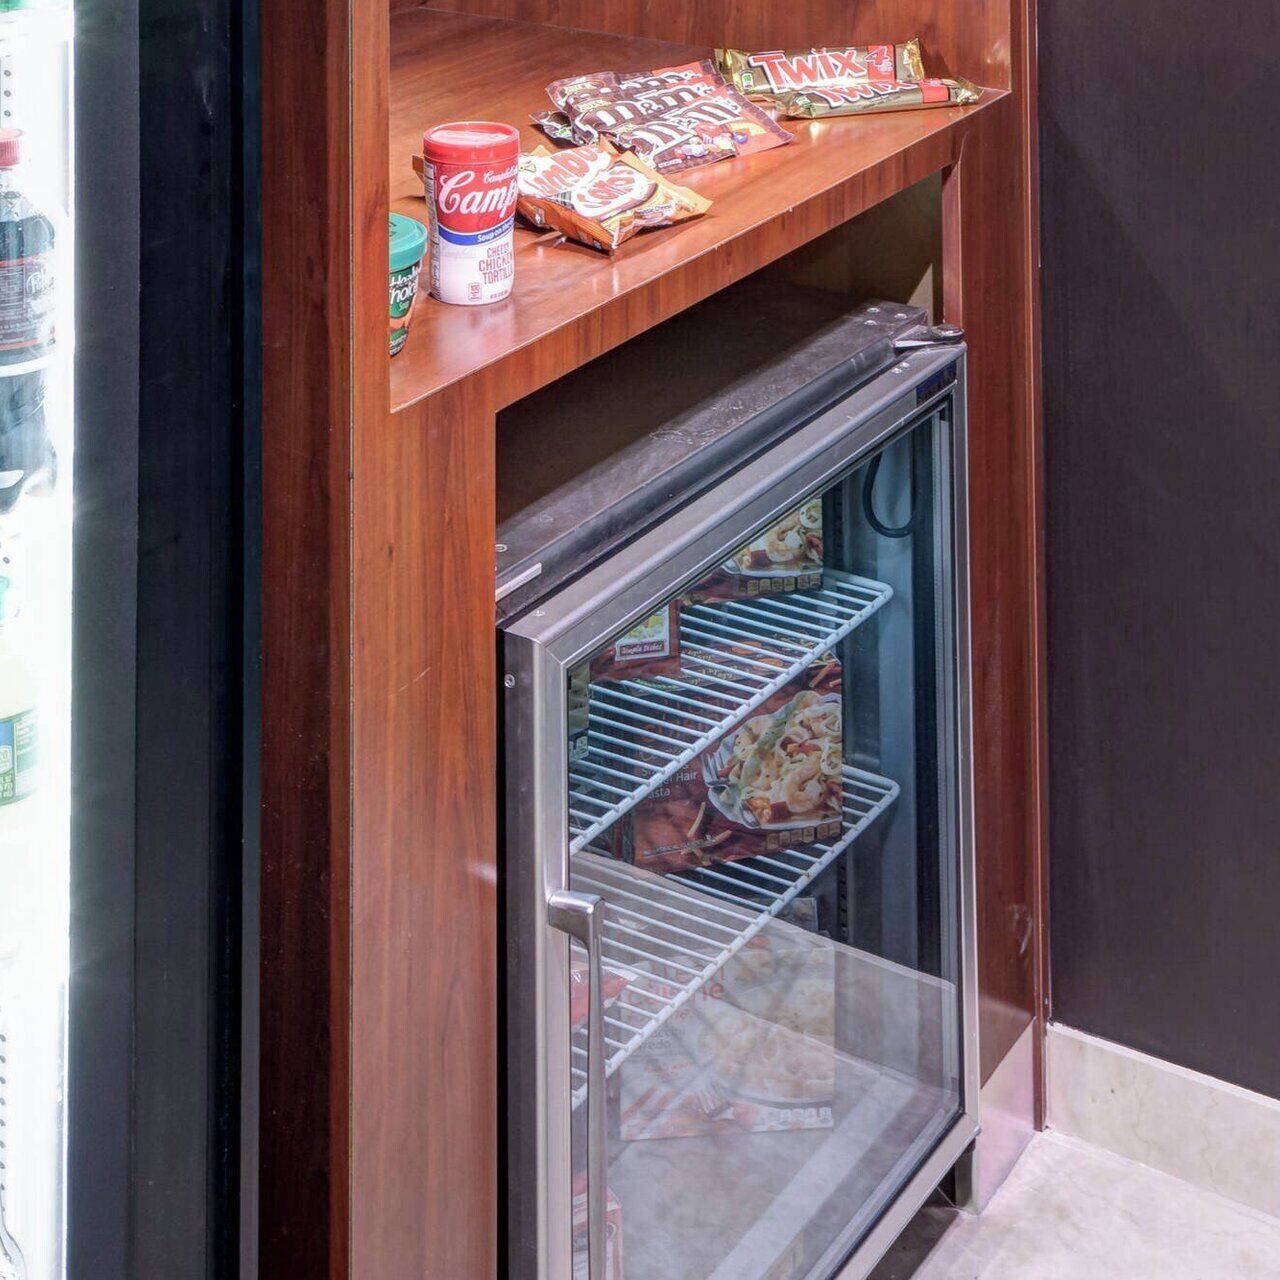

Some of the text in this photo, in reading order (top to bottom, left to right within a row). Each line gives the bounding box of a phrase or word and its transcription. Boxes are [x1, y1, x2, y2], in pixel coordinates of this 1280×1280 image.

[749, 47, 869, 94] TWIX
[477, 229, 503, 244] Soup on
[676, 770, 698, 784] Hair
[646, 788, 672, 800] asta
